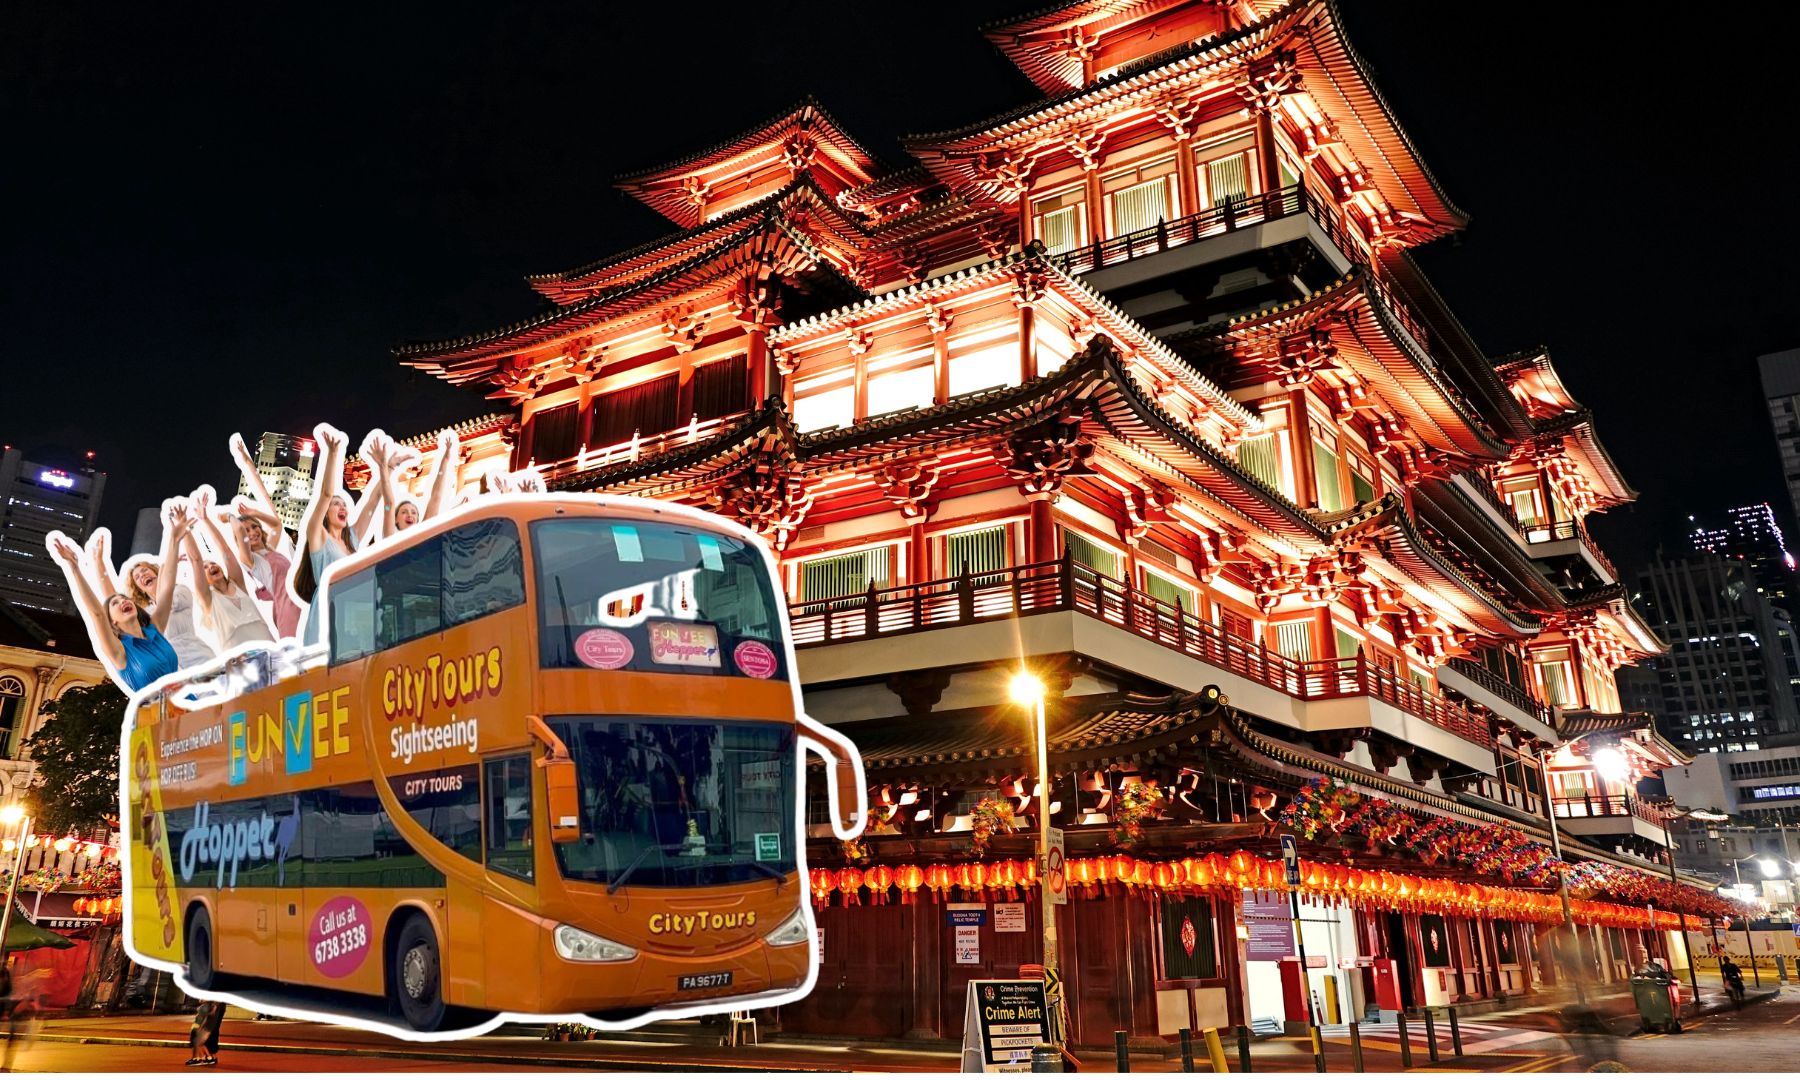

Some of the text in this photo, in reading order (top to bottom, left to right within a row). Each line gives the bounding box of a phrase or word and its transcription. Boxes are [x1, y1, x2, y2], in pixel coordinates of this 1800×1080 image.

[160, 741, 189, 760] Experience
[199, 727, 212, 747] HOP
[212, 723, 223, 744] ON
[231, 685, 351, 777] FUNVEE
[390, 713, 479, 765] Sightseeing
[160, 767, 172, 785] HOP
[172, 764, 184, 783] OFF
[405, 775, 463, 795] CITY TOURS
[180, 800, 275, 892] Hopper
[319, 903, 357, 935] Call us at
[315, 923, 367, 964] 6738 3338
[1000, 985, 1038, 993] Crime Prevention
[985, 1006, 1041, 1020] Crime Alert
[1000, 1038, 1034, 1046] PICKPOCKETS
